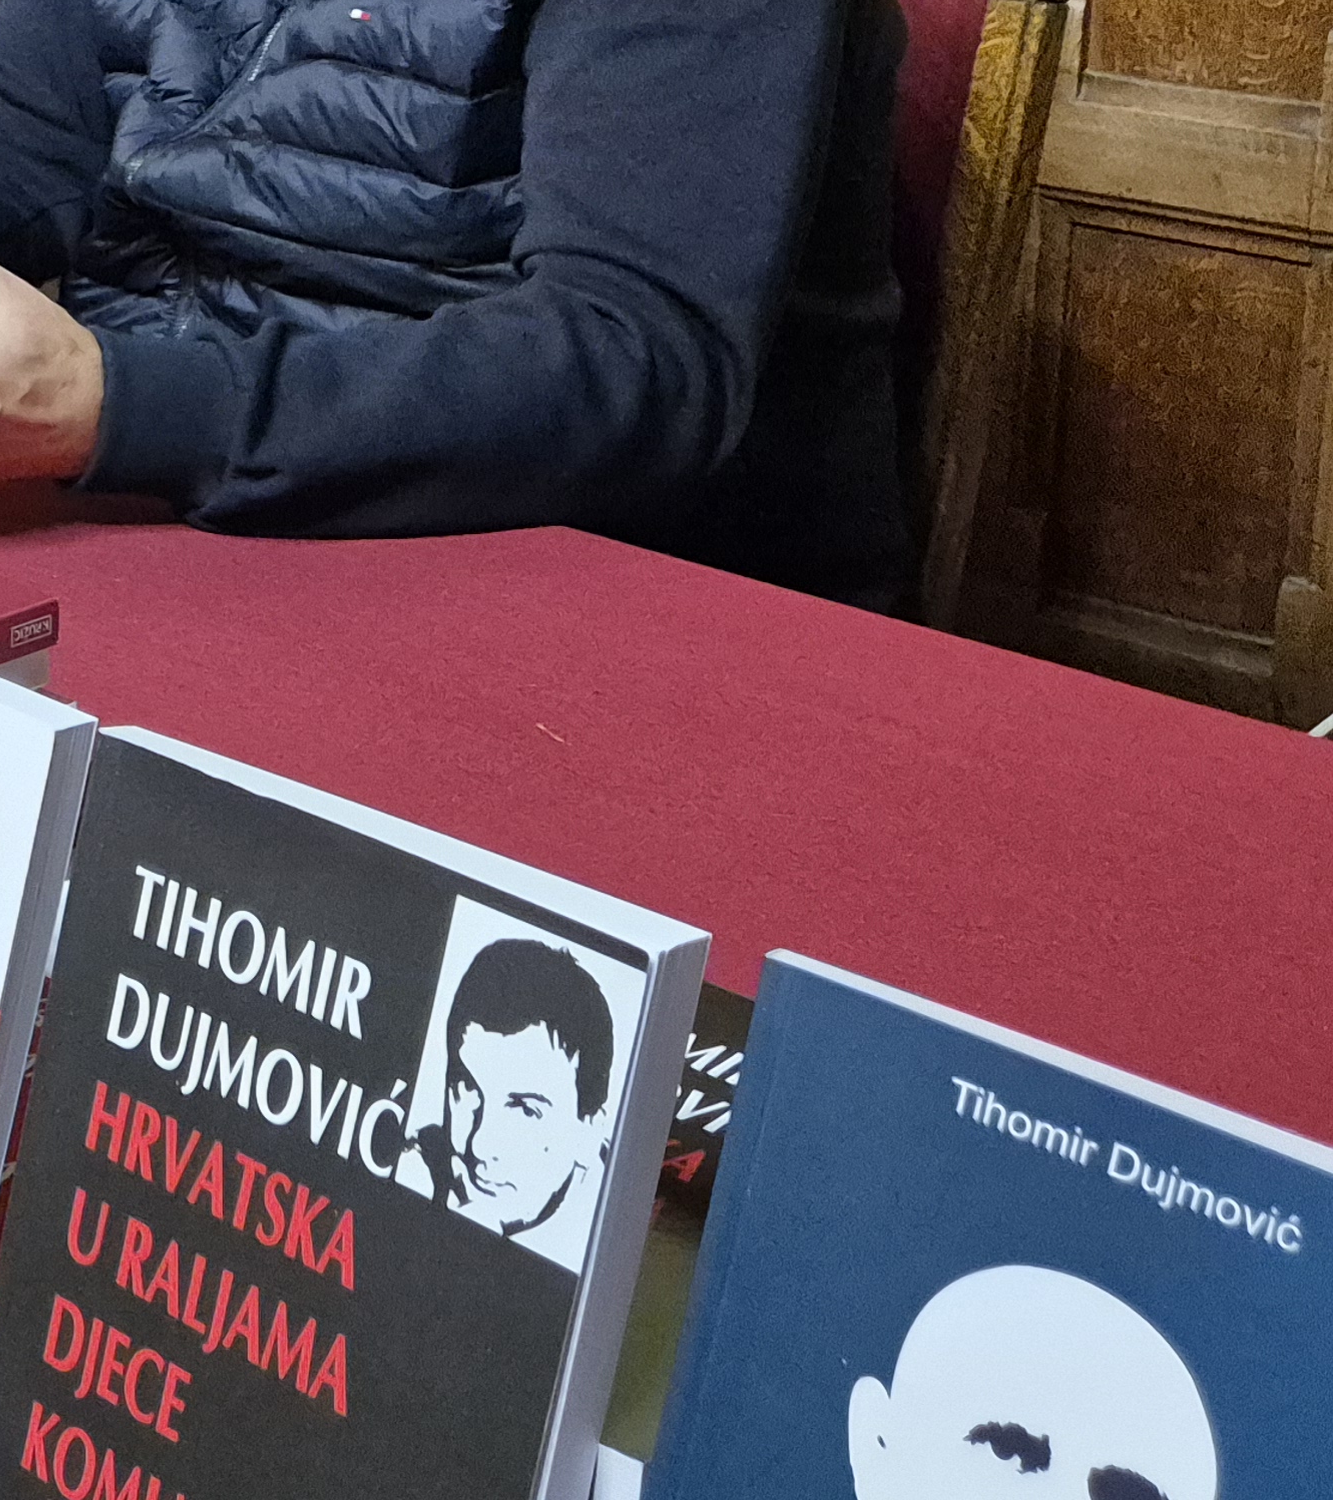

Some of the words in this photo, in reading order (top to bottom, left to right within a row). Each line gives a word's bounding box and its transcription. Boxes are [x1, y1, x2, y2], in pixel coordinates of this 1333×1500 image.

[132, 864, 372, 1041] TIHOMIR
[105, 972, 408, 1179] DUJMOVIĆ
[950, 1075, 1100, 1169] Tihomir
[1105, 1140, 1305, 1254] Dujmović
[83, 1079, 356, 1292] HRVATSKA
[42, 1293, 193, 1443] DJECE
[65, 1186, 109, 1268] U
[115, 1214, 348, 1418] RALJAMA
